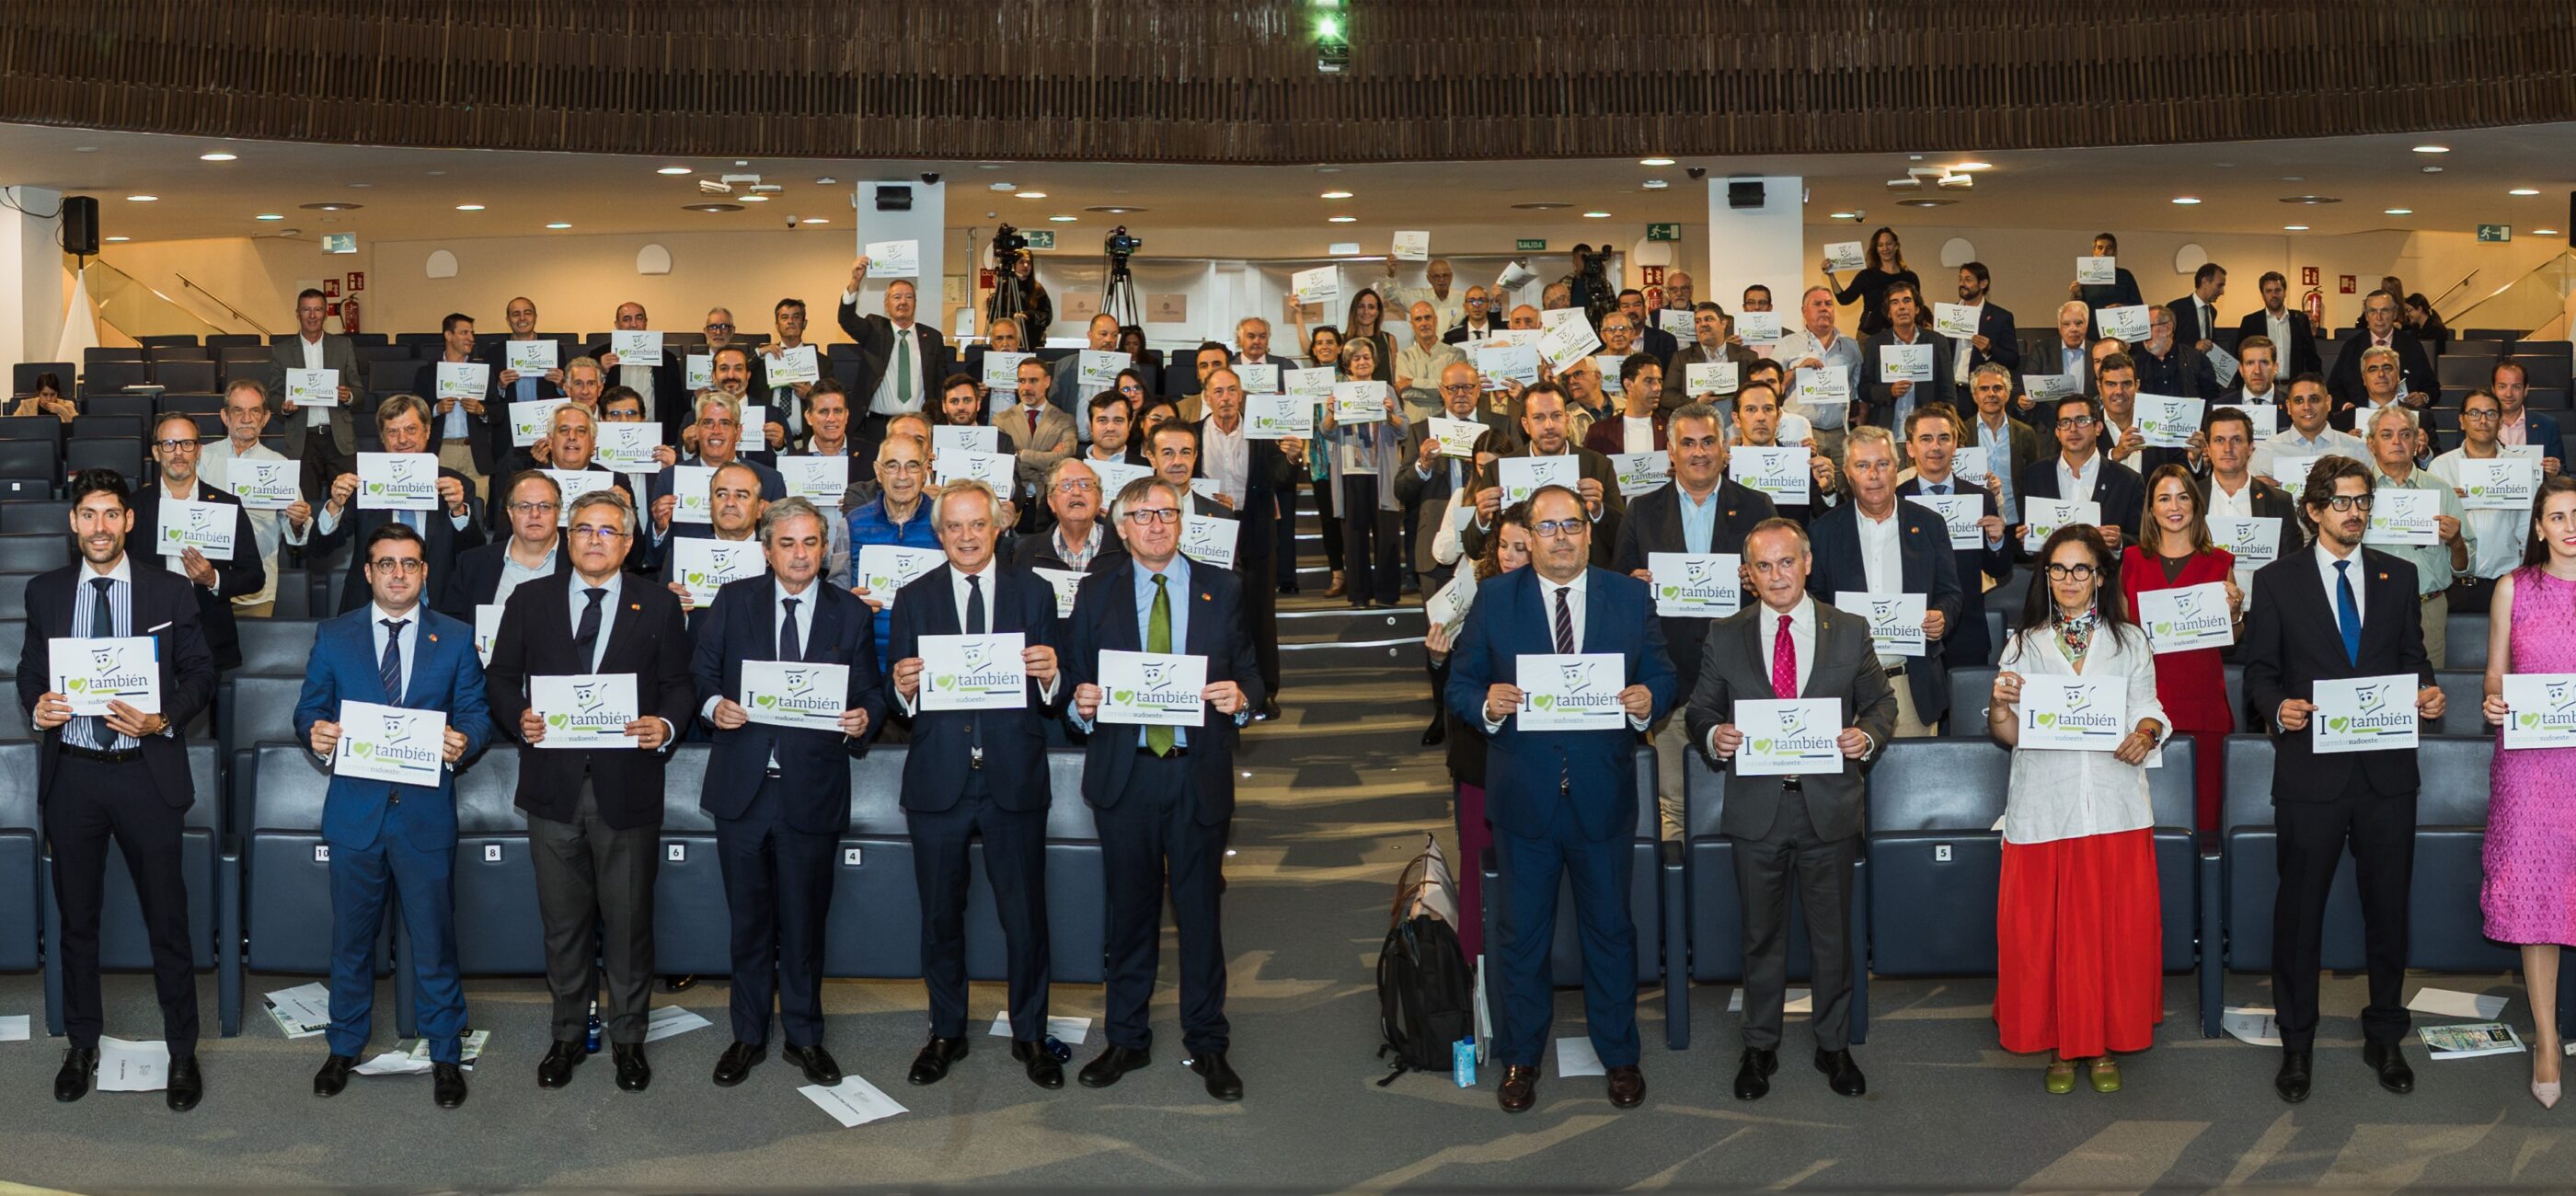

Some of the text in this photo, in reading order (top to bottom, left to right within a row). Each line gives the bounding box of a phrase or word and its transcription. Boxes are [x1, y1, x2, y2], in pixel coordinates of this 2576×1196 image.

[1274, 417, 1310, 426] también
[2158, 421, 2197, 432] también
[615, 448, 654, 457] tambié
[1631, 471, 1667, 481] también
[1759, 477, 1805, 487] también
[253, 485, 295, 495] también
[386, 482, 433, 493] también
[802, 481, 842, 490] también
[2486, 484, 2528, 494] también
[2389, 516, 2433, 527] también
[184, 530, 230, 544] también
[1183, 544, 1230, 558] también
[2231, 542, 2272, 554] también
[680, 569, 687, 587] I
[1654, 582, 1735, 602] I también
[2146, 615, 2227, 639] I también
[481, 636, 488, 653] I
[60, 673, 148, 695] I también
[926, 672, 1020, 693] I también
[747, 690, 840, 710] I también
[1104, 686, 1200, 706] I también
[1524, 692, 1618, 712] I también
[570, 711, 632, 725] también
[2028, 709, 2117, 729] I también
[2319, 712, 2413, 735] I también
[2510, 710, 2576, 730] I tamb
[343, 736, 436, 762] I también
[1744, 736, 1834, 755] I también
[317, 849, 328, 857] 10
[489, 848, 496, 857] 8
[673, 848, 679, 857] 6
[1940, 849, 1947, 857] 5
